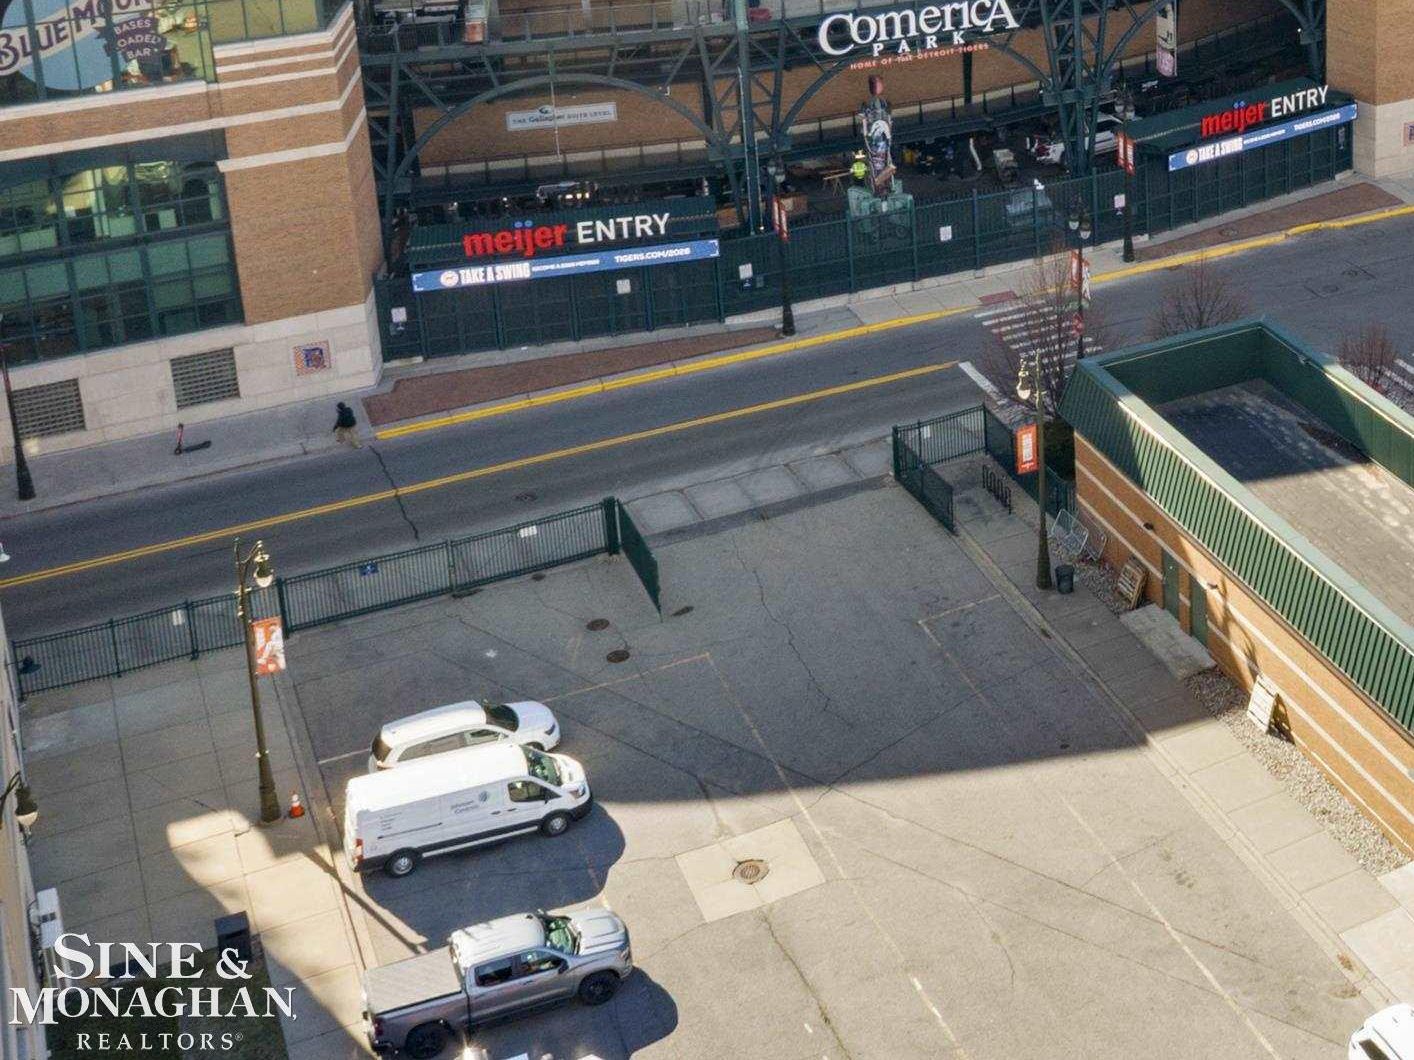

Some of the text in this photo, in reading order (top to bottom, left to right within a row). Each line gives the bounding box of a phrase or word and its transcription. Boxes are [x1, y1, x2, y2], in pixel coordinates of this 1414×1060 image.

[114, 18, 151, 35] BASES
[0, 17, 69, 71] BLUE
[115, 33, 161, 52] OADE
[126, 48, 150, 59] BAR
[850, 60, 877, 70] HOME
[917, 47, 956, 60] DETROIT
[958, 42, 989, 53] TIGERS
[872, 30, 965, 57] PARK
[1201, 85, 1328, 137] meijer ENTRY
[463, 212, 670, 257] meijer ENTRY
[459, 262, 530, 285] TAKE A SWING
